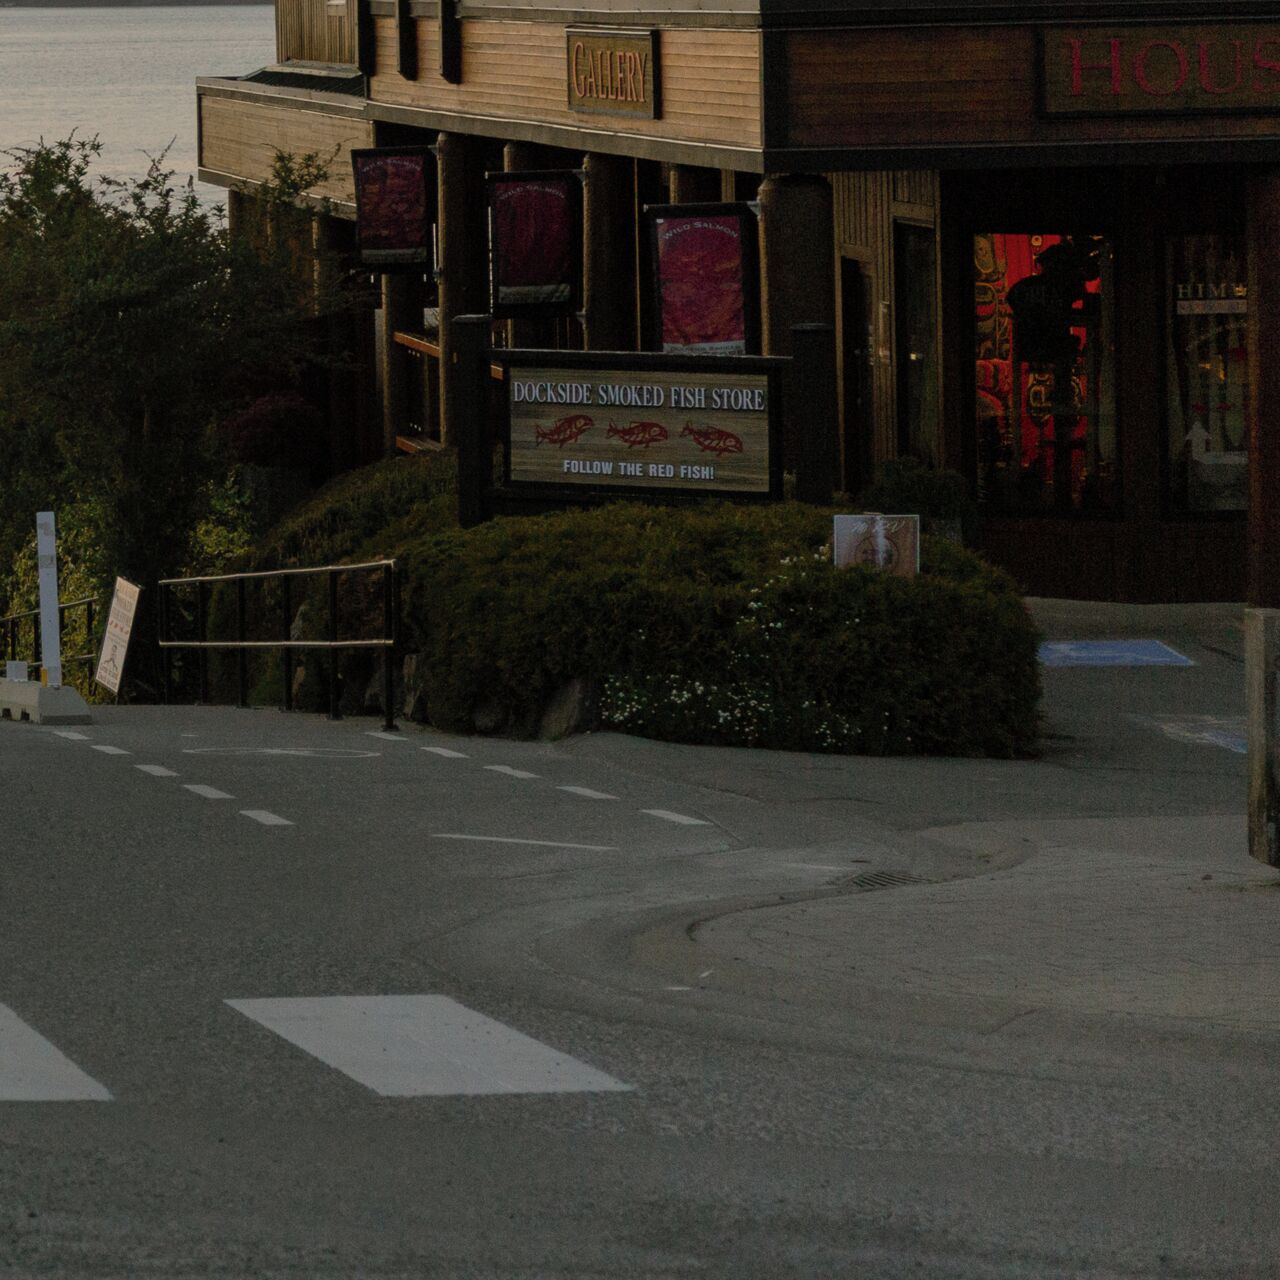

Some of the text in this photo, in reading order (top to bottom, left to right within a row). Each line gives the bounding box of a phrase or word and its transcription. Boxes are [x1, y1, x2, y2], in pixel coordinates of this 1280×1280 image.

[572, 42, 648, 103] GALLERY
[662, 221, 738, 240] WILD SALMON
[513, 381, 765, 410] DOCKSIDE SMOKED FISH STORE
[563, 459, 715, 480] FOLLOW THE RED FISH!
